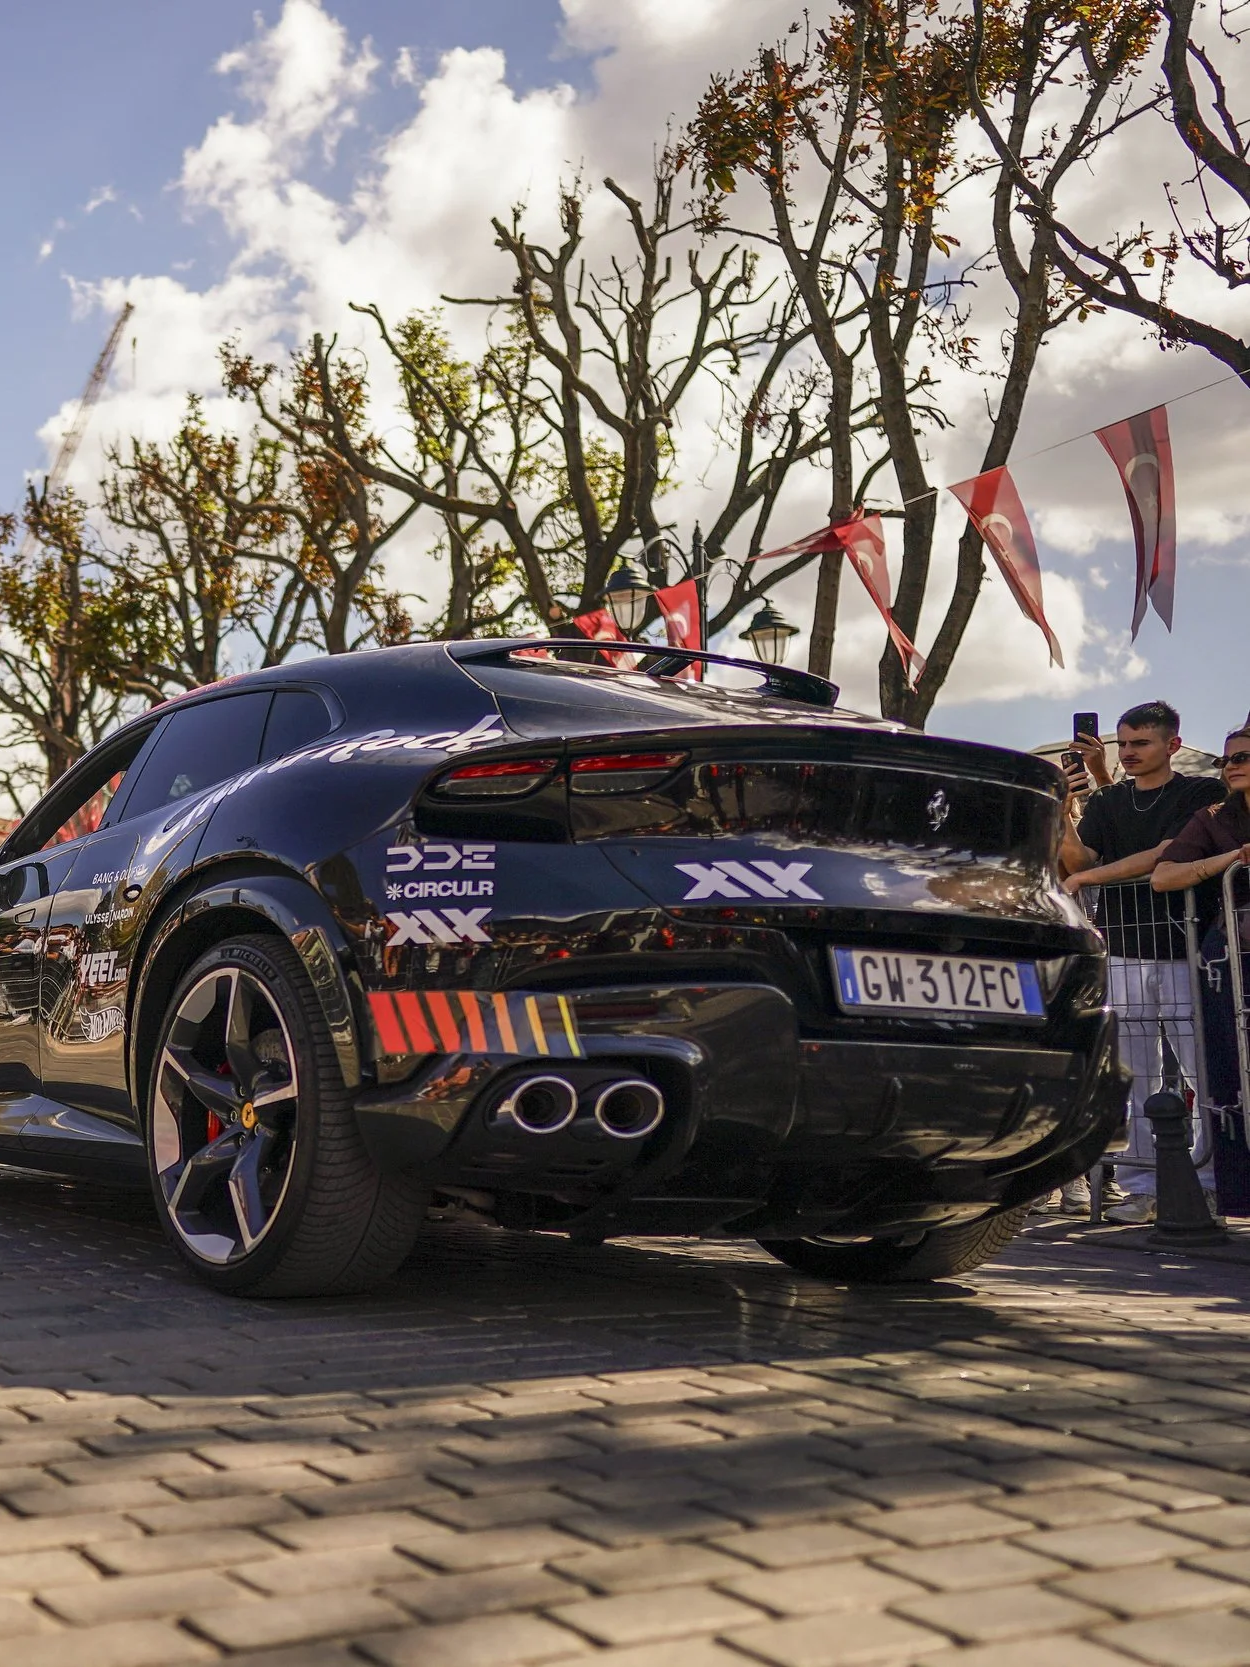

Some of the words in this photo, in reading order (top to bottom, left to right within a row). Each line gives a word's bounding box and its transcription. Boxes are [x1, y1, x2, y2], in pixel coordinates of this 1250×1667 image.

[386, 844, 496, 873] DDE
[92, 871, 115, 885] BANG
[113, 870, 120, 883] &
[403, 880, 495, 899] CIRCULR
[673, 860, 824, 900] XIX
[85, 912, 110, 925] ULYSSE
[112, 906, 136, 921] NARDIN
[385, 907, 493, 947] XIX
[859, 955, 906, 1003] GW
[915, 958, 1021, 1010] 312FC
